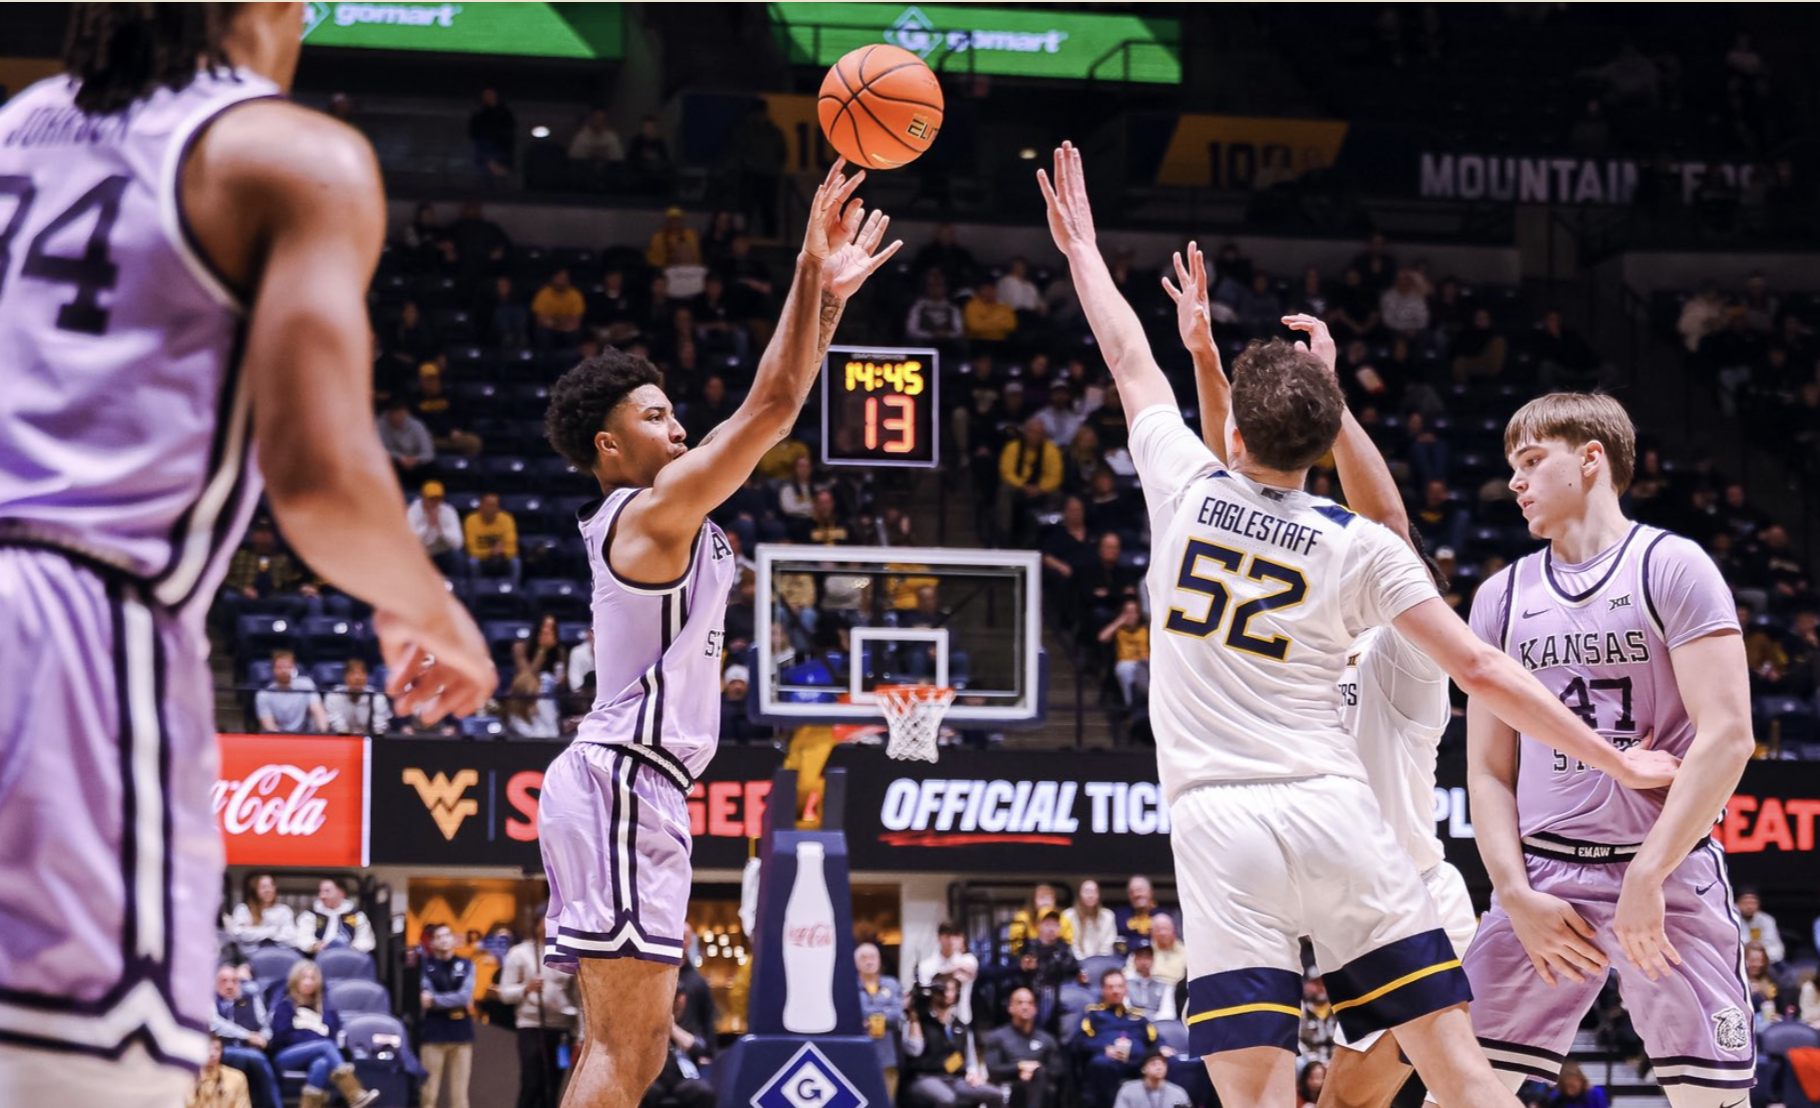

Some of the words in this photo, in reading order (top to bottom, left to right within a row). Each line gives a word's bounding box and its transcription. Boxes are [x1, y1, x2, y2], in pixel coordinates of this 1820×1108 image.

[334, 4, 454, 28] gomart
[845, 361, 924, 396] 14:45
[864, 394, 915, 453] 13
[1197, 496, 1323, 556] EAGLESTAFF
[1163, 536, 1310, 662] 52
[1518, 629, 1651, 672] KANSAS
[1559, 675, 1636, 732] 47
[880, 778, 1079, 833] OFFICIAL
[1711, 794, 1820, 853] EAT
[1578, 846, 1611, 858] EMAW
